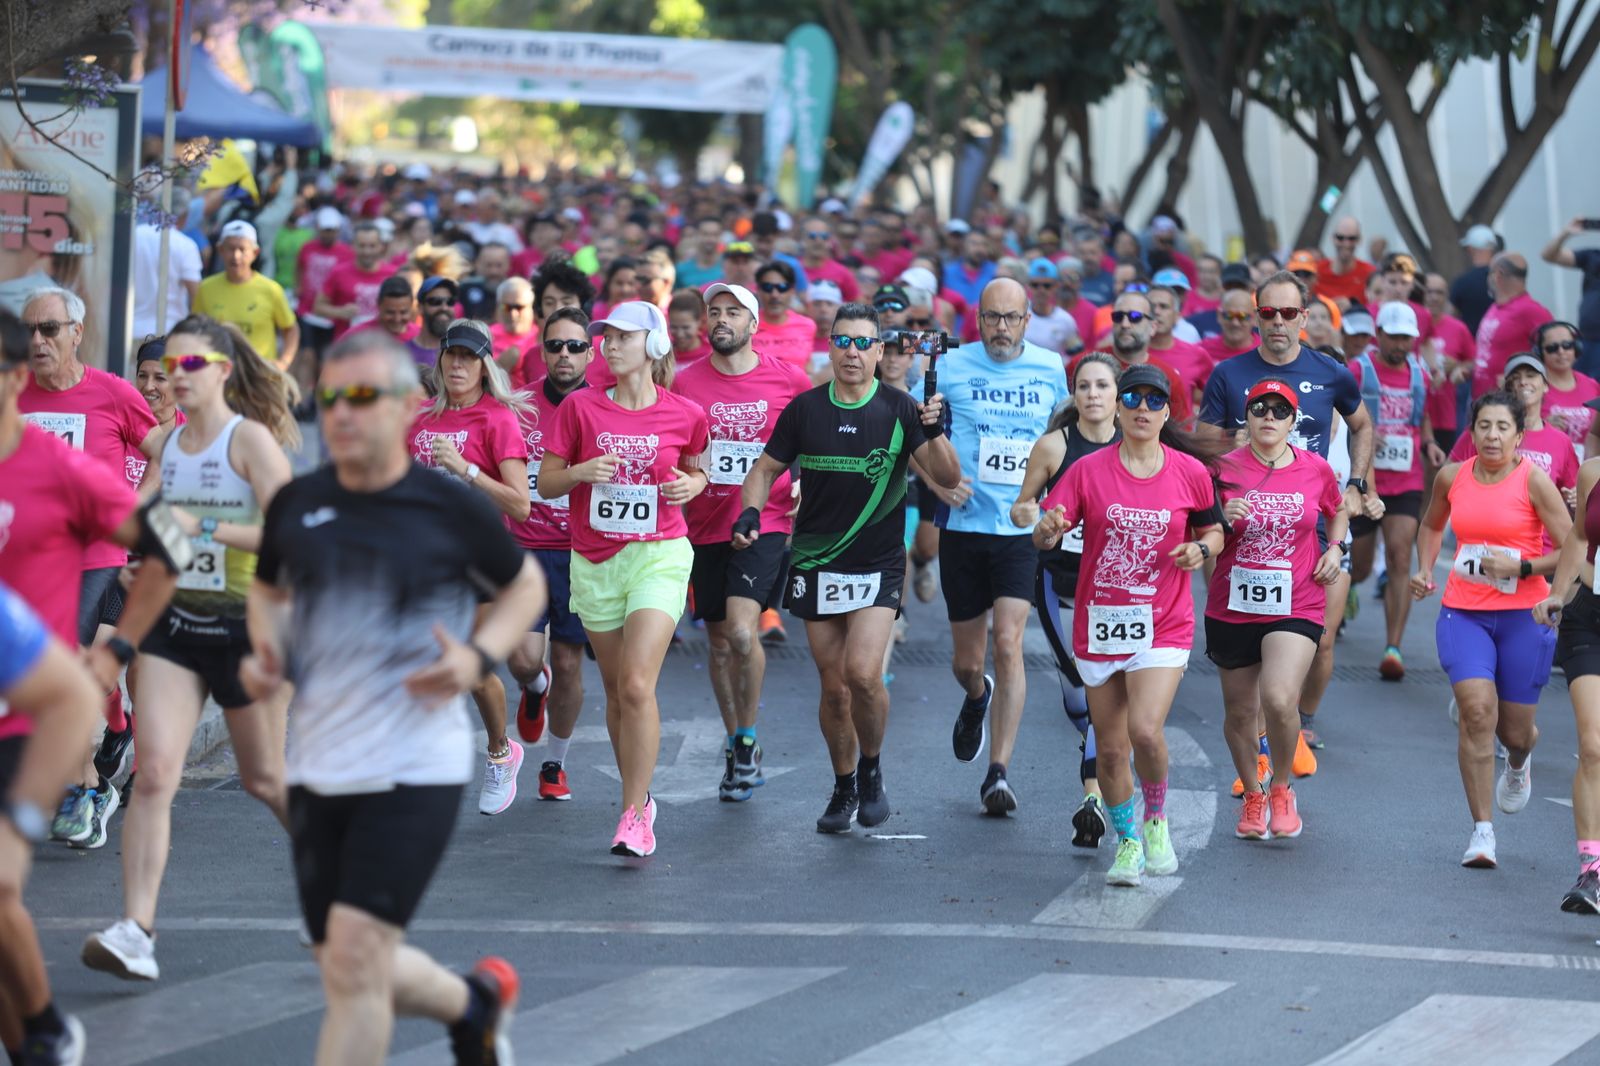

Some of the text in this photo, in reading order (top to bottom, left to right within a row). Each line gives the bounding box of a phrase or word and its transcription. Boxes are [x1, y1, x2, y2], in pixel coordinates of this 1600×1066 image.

[972, 385, 1040, 408] nerja
[982, 408, 1034, 418] ATLETISMO
[719, 456, 758, 473] 31
[598, 500, 650, 520] 670
[825, 583, 872, 601] 217
[1237, 583, 1282, 603] 191
[1096, 621, 1146, 641] 343
